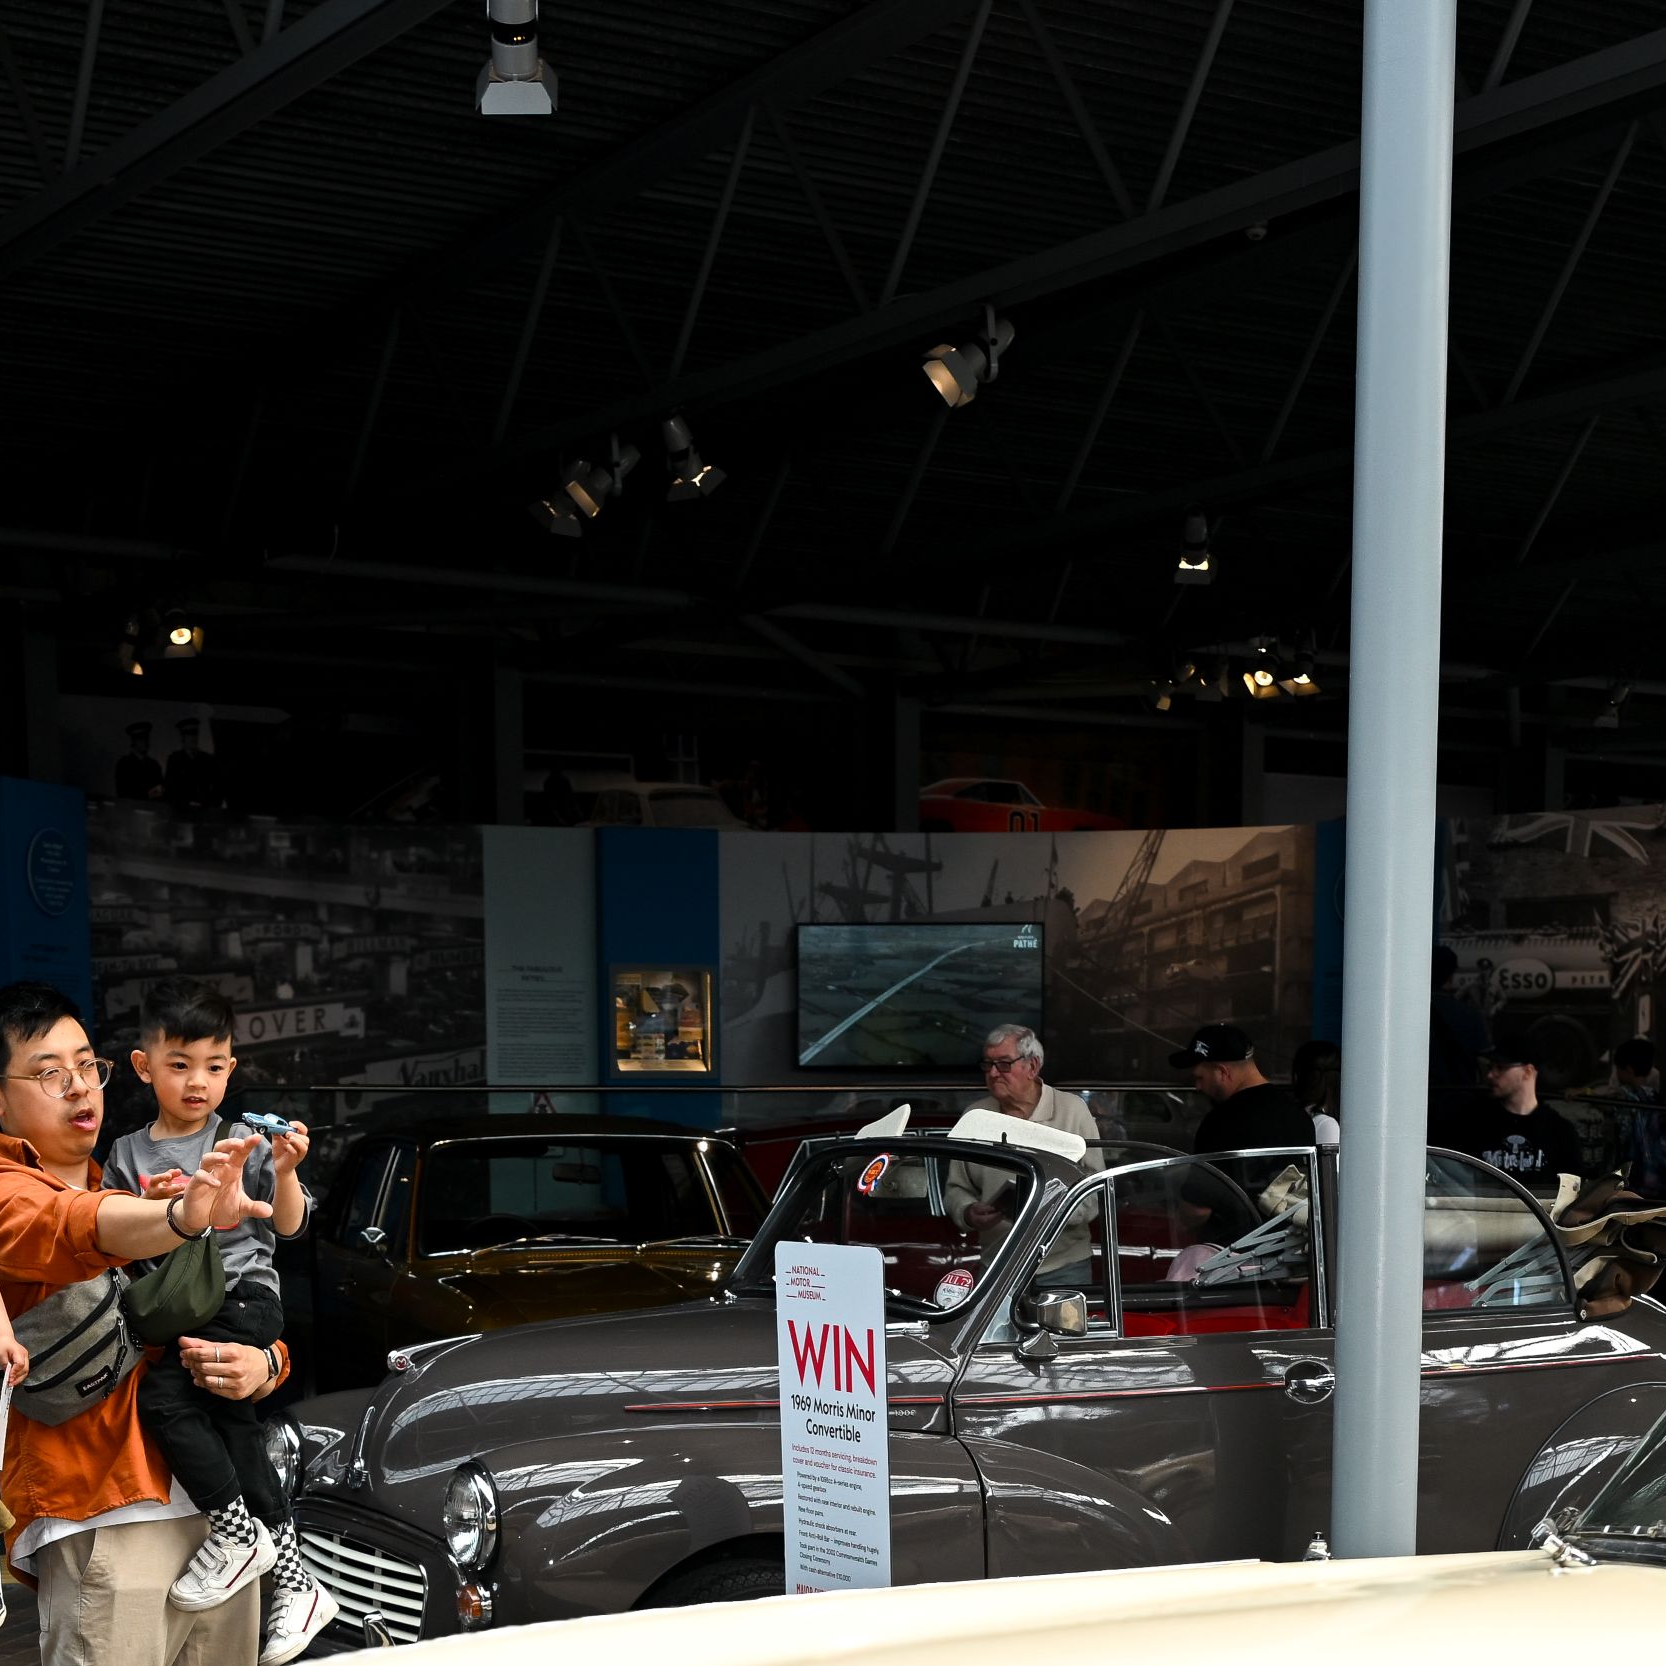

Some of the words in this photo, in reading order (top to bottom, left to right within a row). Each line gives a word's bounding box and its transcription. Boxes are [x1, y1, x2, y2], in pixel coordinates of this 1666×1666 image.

[429, 947, 484, 967] HUMBE
[1571, 975, 1605, 984] PETR
[235, 1008, 327, 1043] OVER
[791, 1265, 821, 1277] NATIONAL
[942, 1273, 960, 1286] JUL
[960, 1276, 972, 1288] 72
[790, 1278, 812, 1289] MOTOR
[797, 1290, 822, 1301] MUSEUM
[787, 1319, 876, 1399] WIN
[790, 1394, 812, 1412] 1969
[813, 1401, 844, 1418] Morris
[846, 1405, 876, 1423] Minor
[805, 1419, 862, 1443] Convertible
[792, 1443, 810, 1453] Includes
[810, 1446, 815, 1454] 12
[815, 1448, 832, 1457] months
[852, 1453, 878, 1465] breakdown
[793, 1456, 805, 1464] cover
[805, 1458, 813, 1466] and
[813, 1460, 831, 1469] voucher
[838, 1465, 854, 1474] classic
